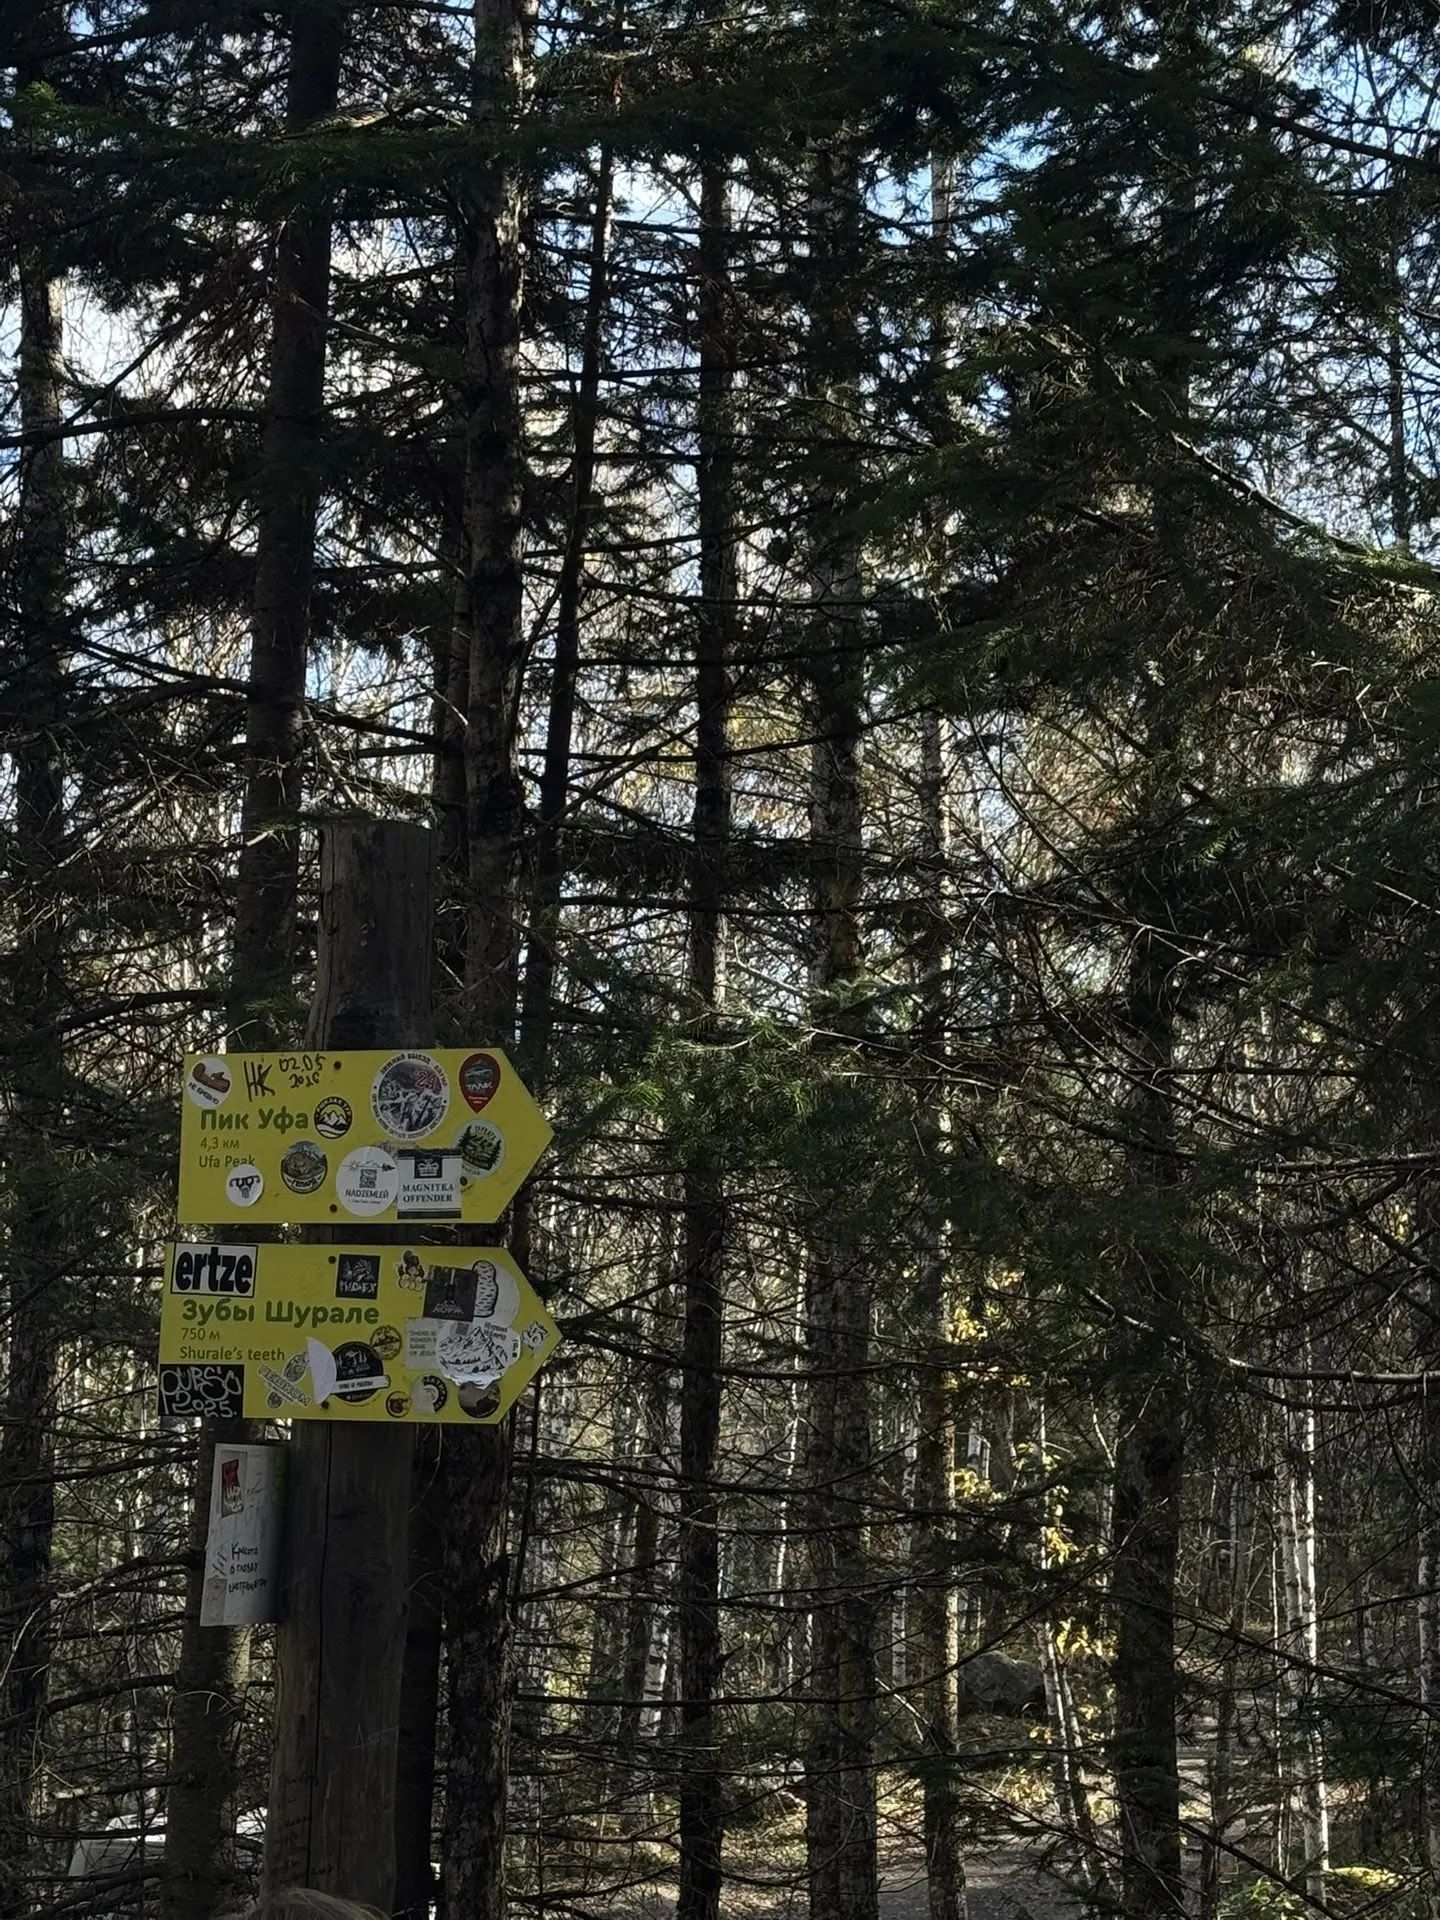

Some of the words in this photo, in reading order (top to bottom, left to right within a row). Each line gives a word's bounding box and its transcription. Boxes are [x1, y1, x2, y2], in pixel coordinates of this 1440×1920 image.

[200, 1108, 249, 1130] Пик
[258, 1105, 309, 1135] Уфа
[200, 1136, 219, 1152] 4,3
[223, 1139, 240, 1149] км
[199, 1155, 220, 1168] Ufa
[225, 1155, 256, 1168] Peak
[403, 1194, 453, 1203] OFFENDER
[176, 1246, 253, 1294] ertze
[182, 1298, 255, 1326] Зубы
[265, 1300, 379, 1328] Шурале
[182, 1328, 206, 1341] 750
[209, 1331, 220, 1341] м
[179, 1346, 243, 1361] Shurale's
[247, 1348, 285, 1361] teeth
